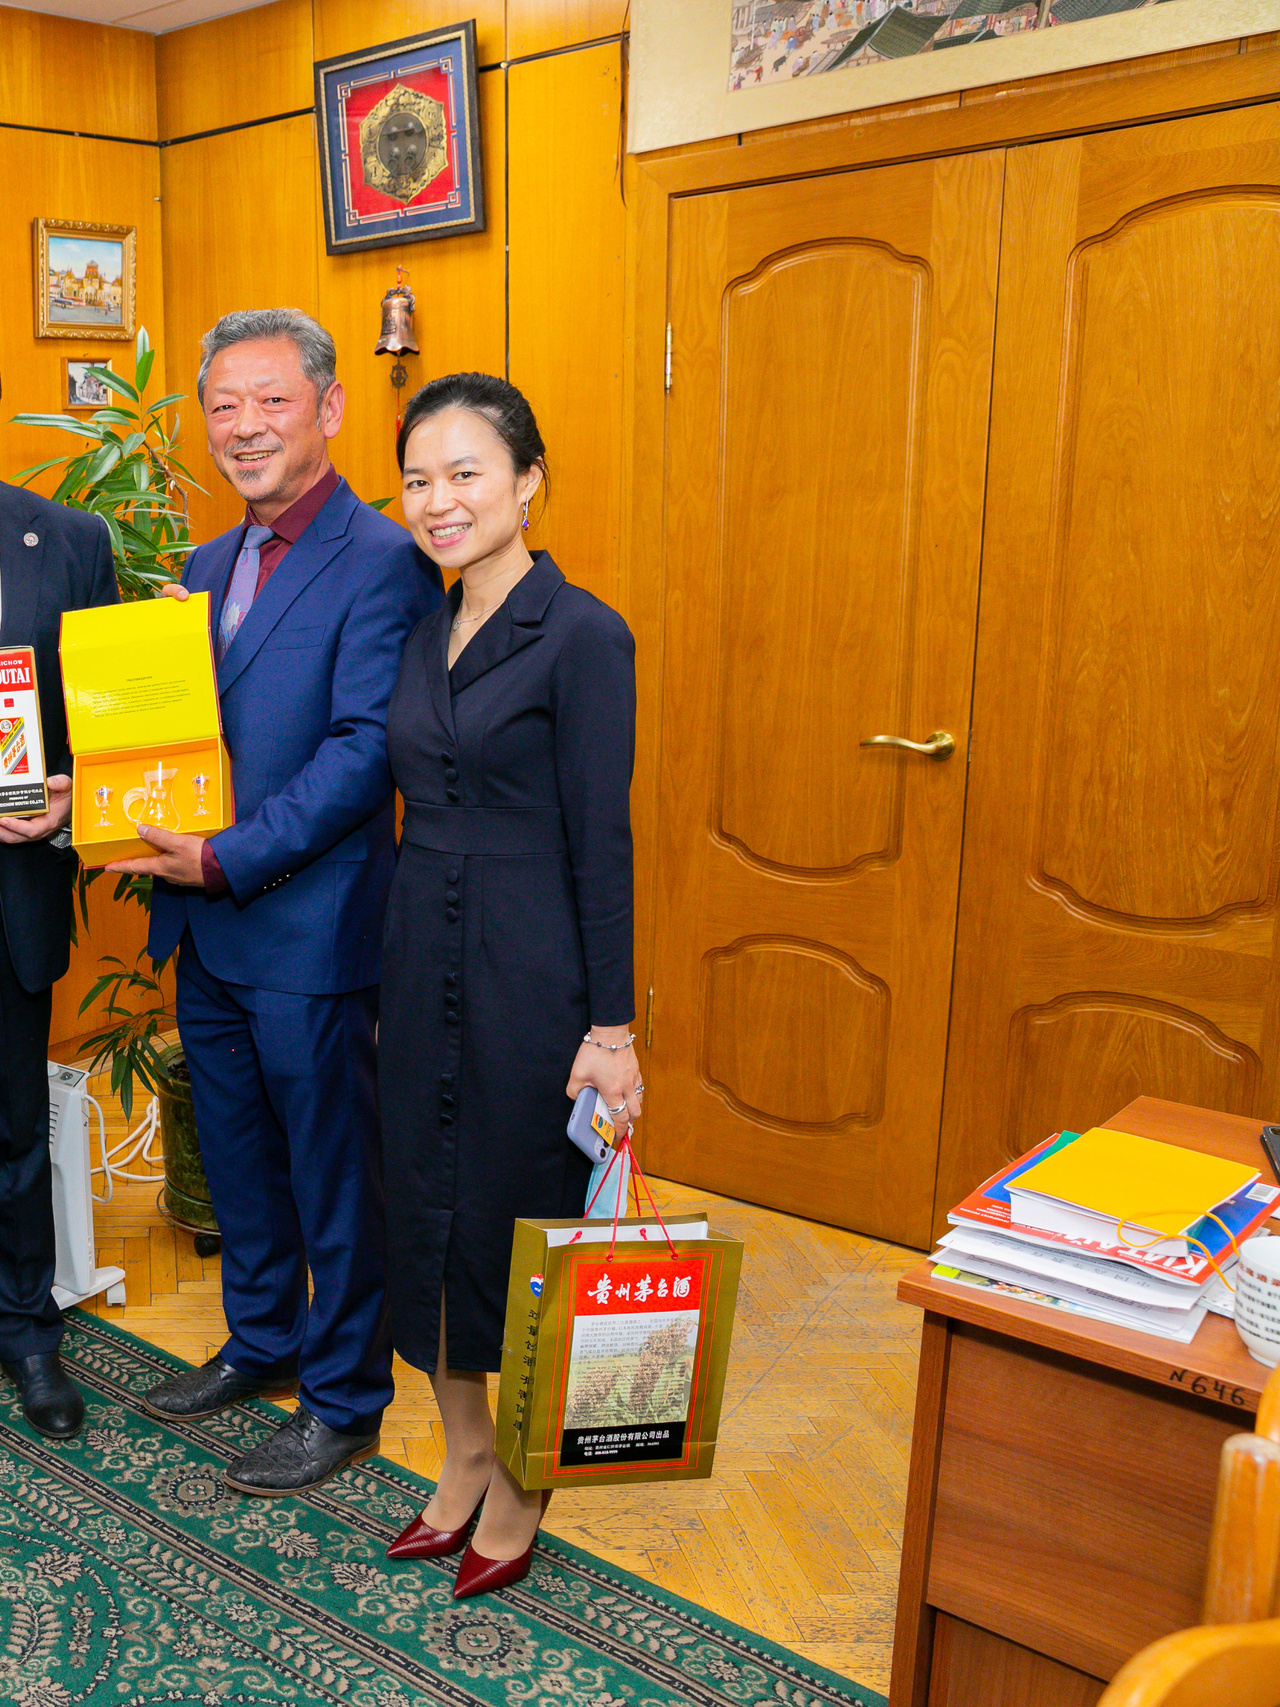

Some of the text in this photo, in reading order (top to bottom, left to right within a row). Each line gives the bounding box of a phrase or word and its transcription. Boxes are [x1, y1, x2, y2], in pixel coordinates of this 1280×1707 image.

[576, 1429, 670, 1445] 贵州茅台酒股份有限公司出品
